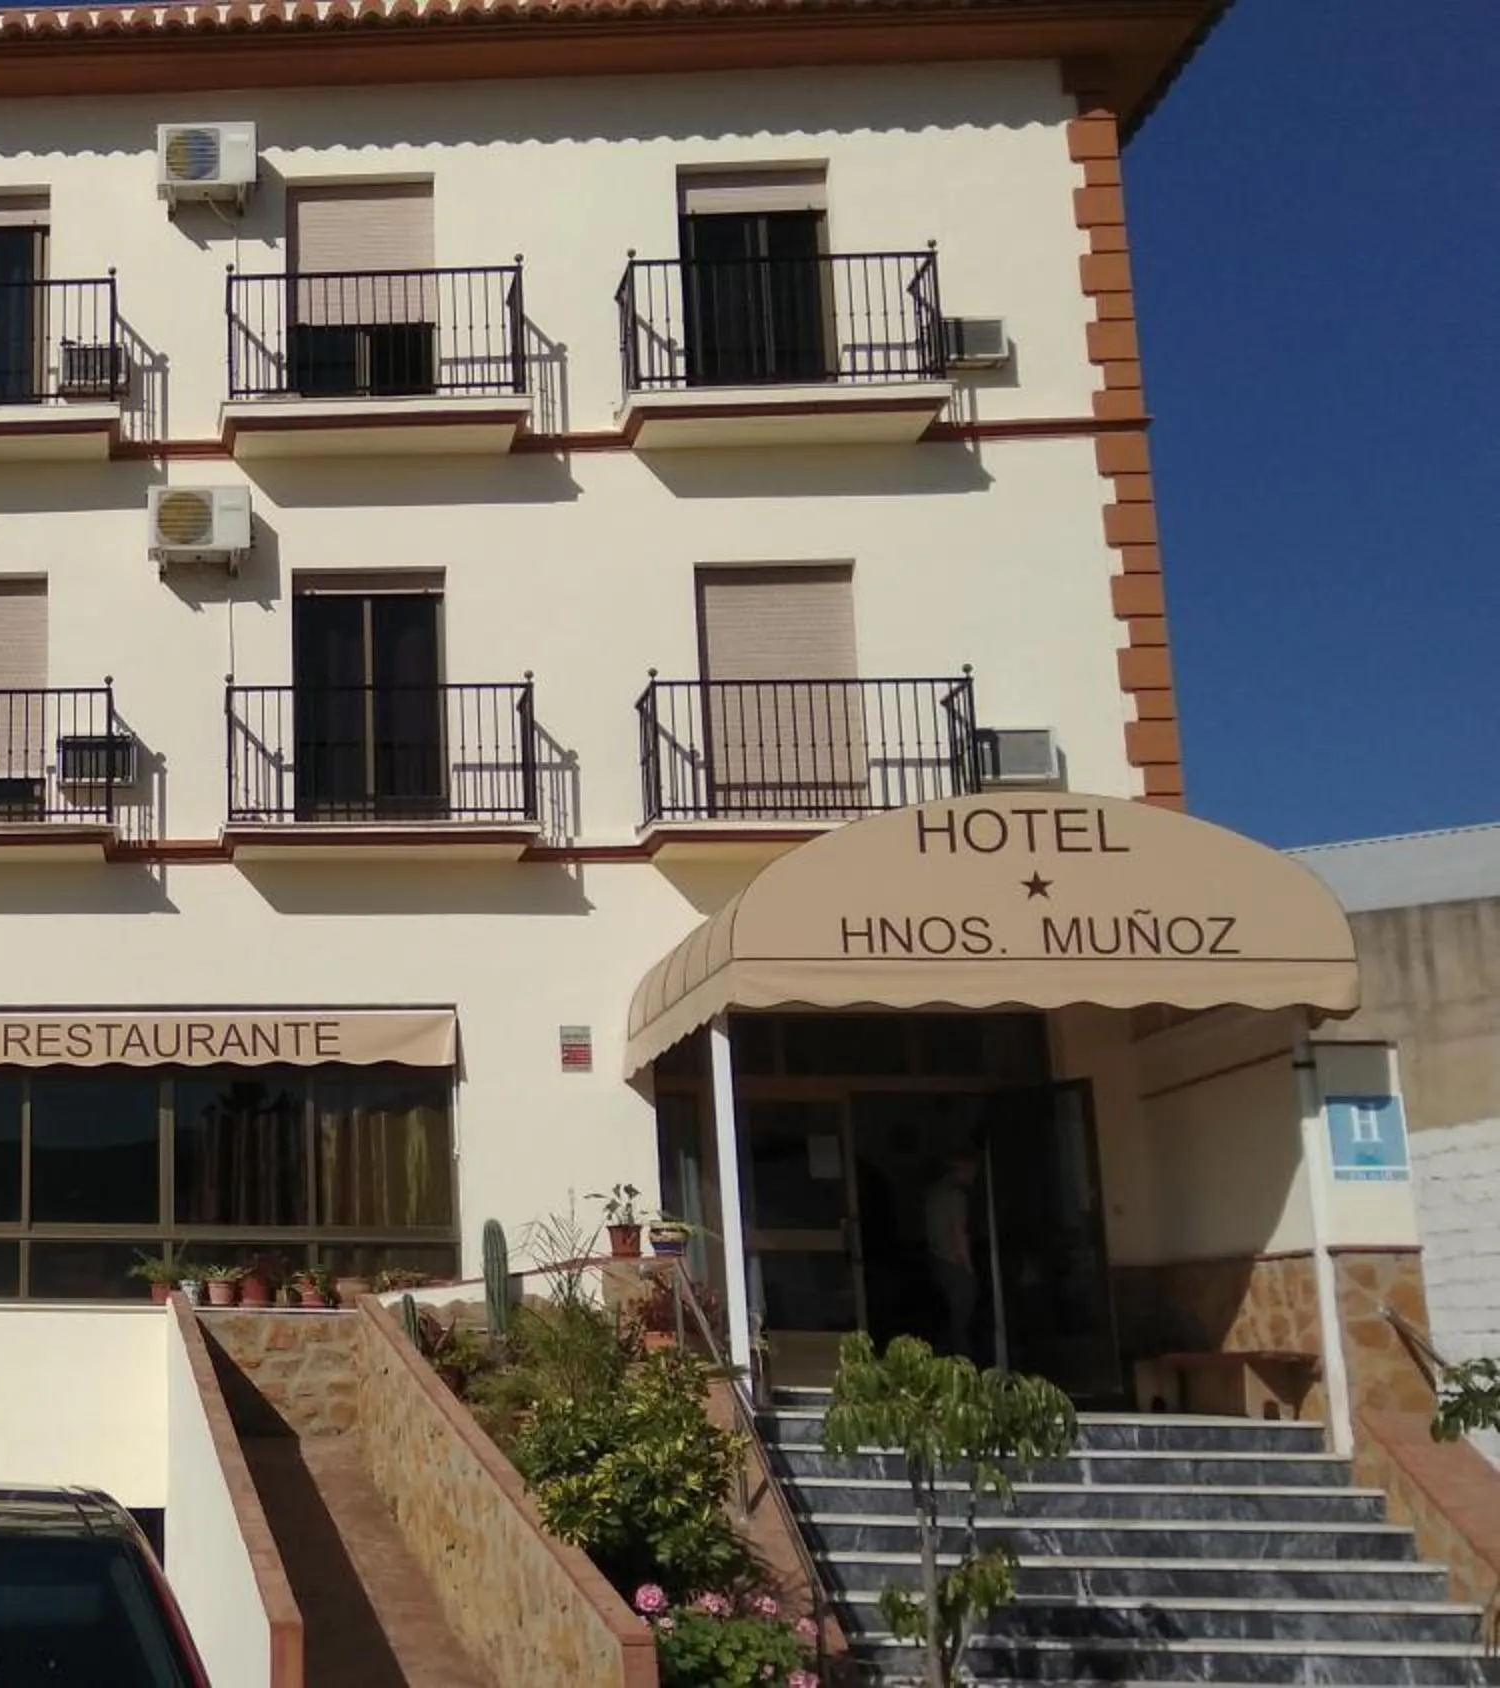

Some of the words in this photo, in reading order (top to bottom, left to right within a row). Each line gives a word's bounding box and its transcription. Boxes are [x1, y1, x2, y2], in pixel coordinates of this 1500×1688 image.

[916, 808, 1131, 854] HOTEL
[840, 916, 1007, 955] HNOS.
[1042, 908, 1241, 955] MUÑOZ
[2, 1020, 342, 1058] RESTAURANTE
[1350, 1105, 1383, 1142] H
